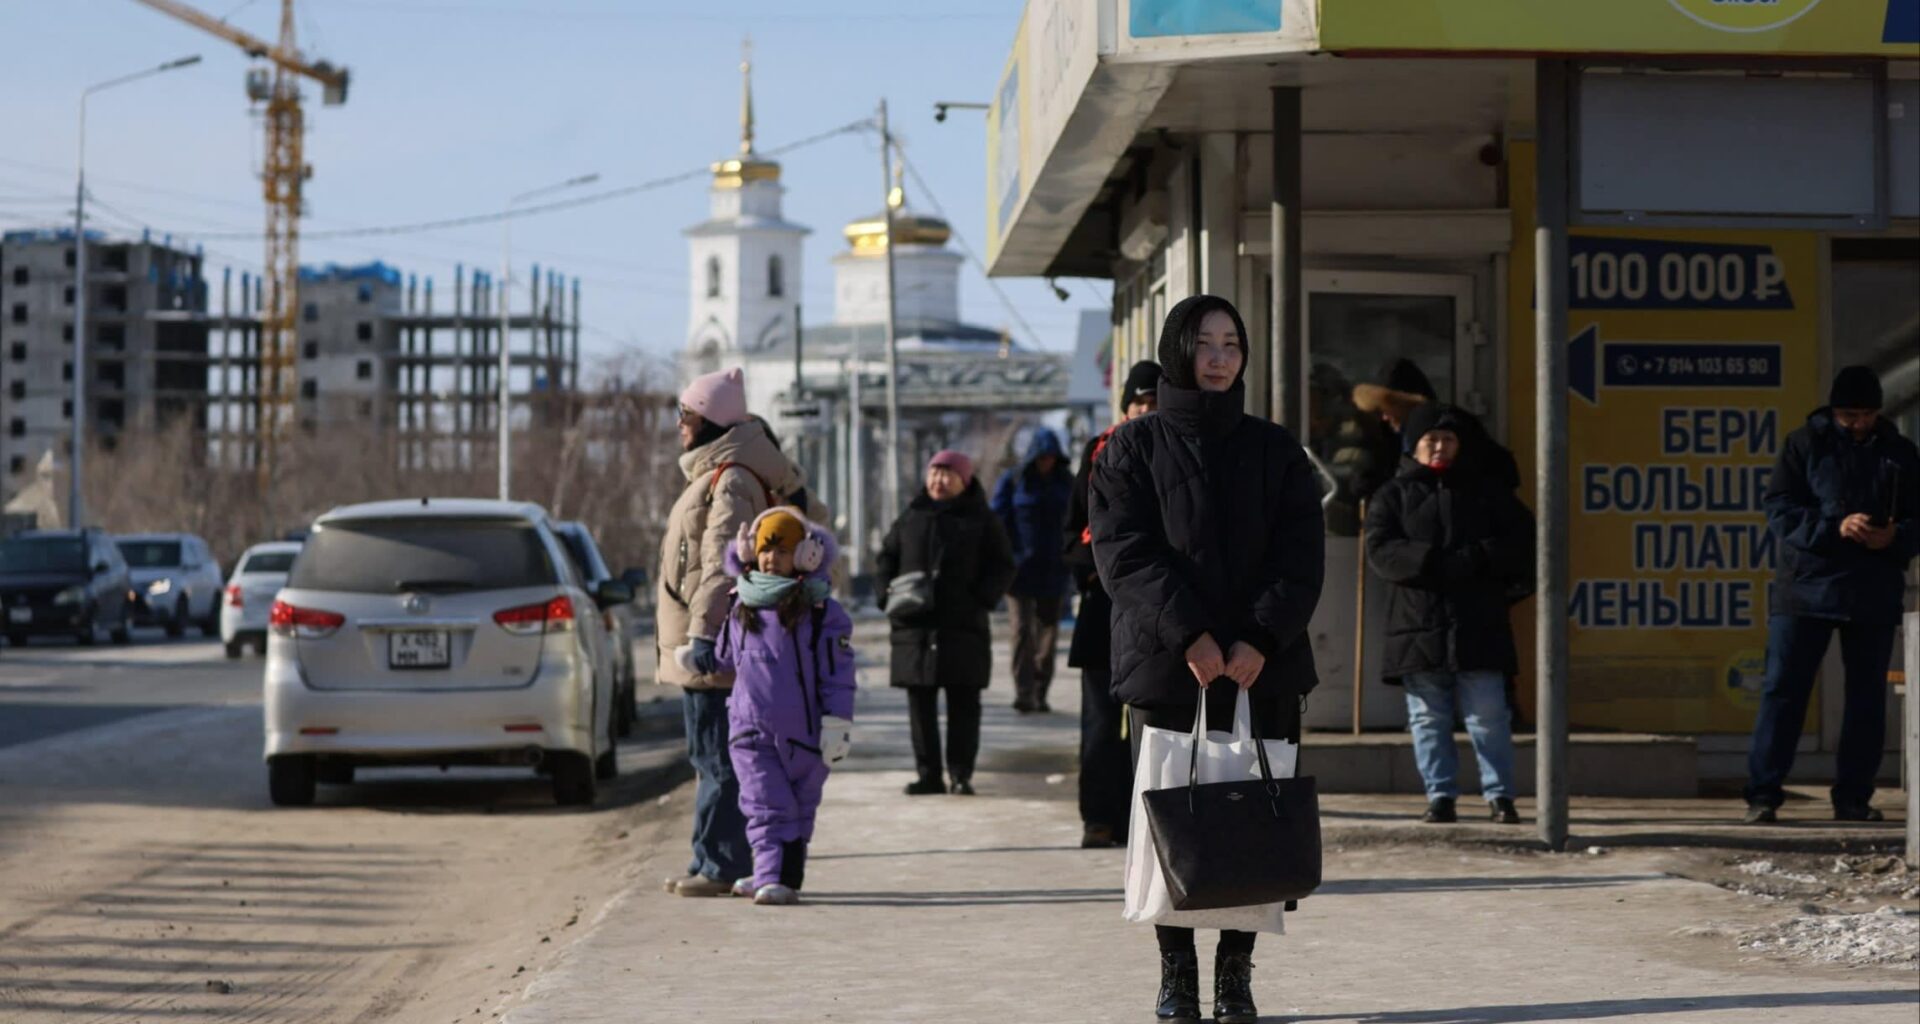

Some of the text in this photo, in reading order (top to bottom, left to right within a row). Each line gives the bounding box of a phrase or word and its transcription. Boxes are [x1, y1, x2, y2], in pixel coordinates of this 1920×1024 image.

[1571, 252, 1647, 300] 100
[1659, 252, 1745, 300] 000
[1668, 356, 1694, 375] 914
[1697, 356, 1723, 375] 103
[1726, 356, 1746, 375] 65
[1747, 356, 1769, 375] 90
[1663, 409, 1777, 454] БЕРИ
[1584, 466, 1775, 511] БОЛЬШЕ
[1634, 524, 1777, 570] ПЛАТИ
